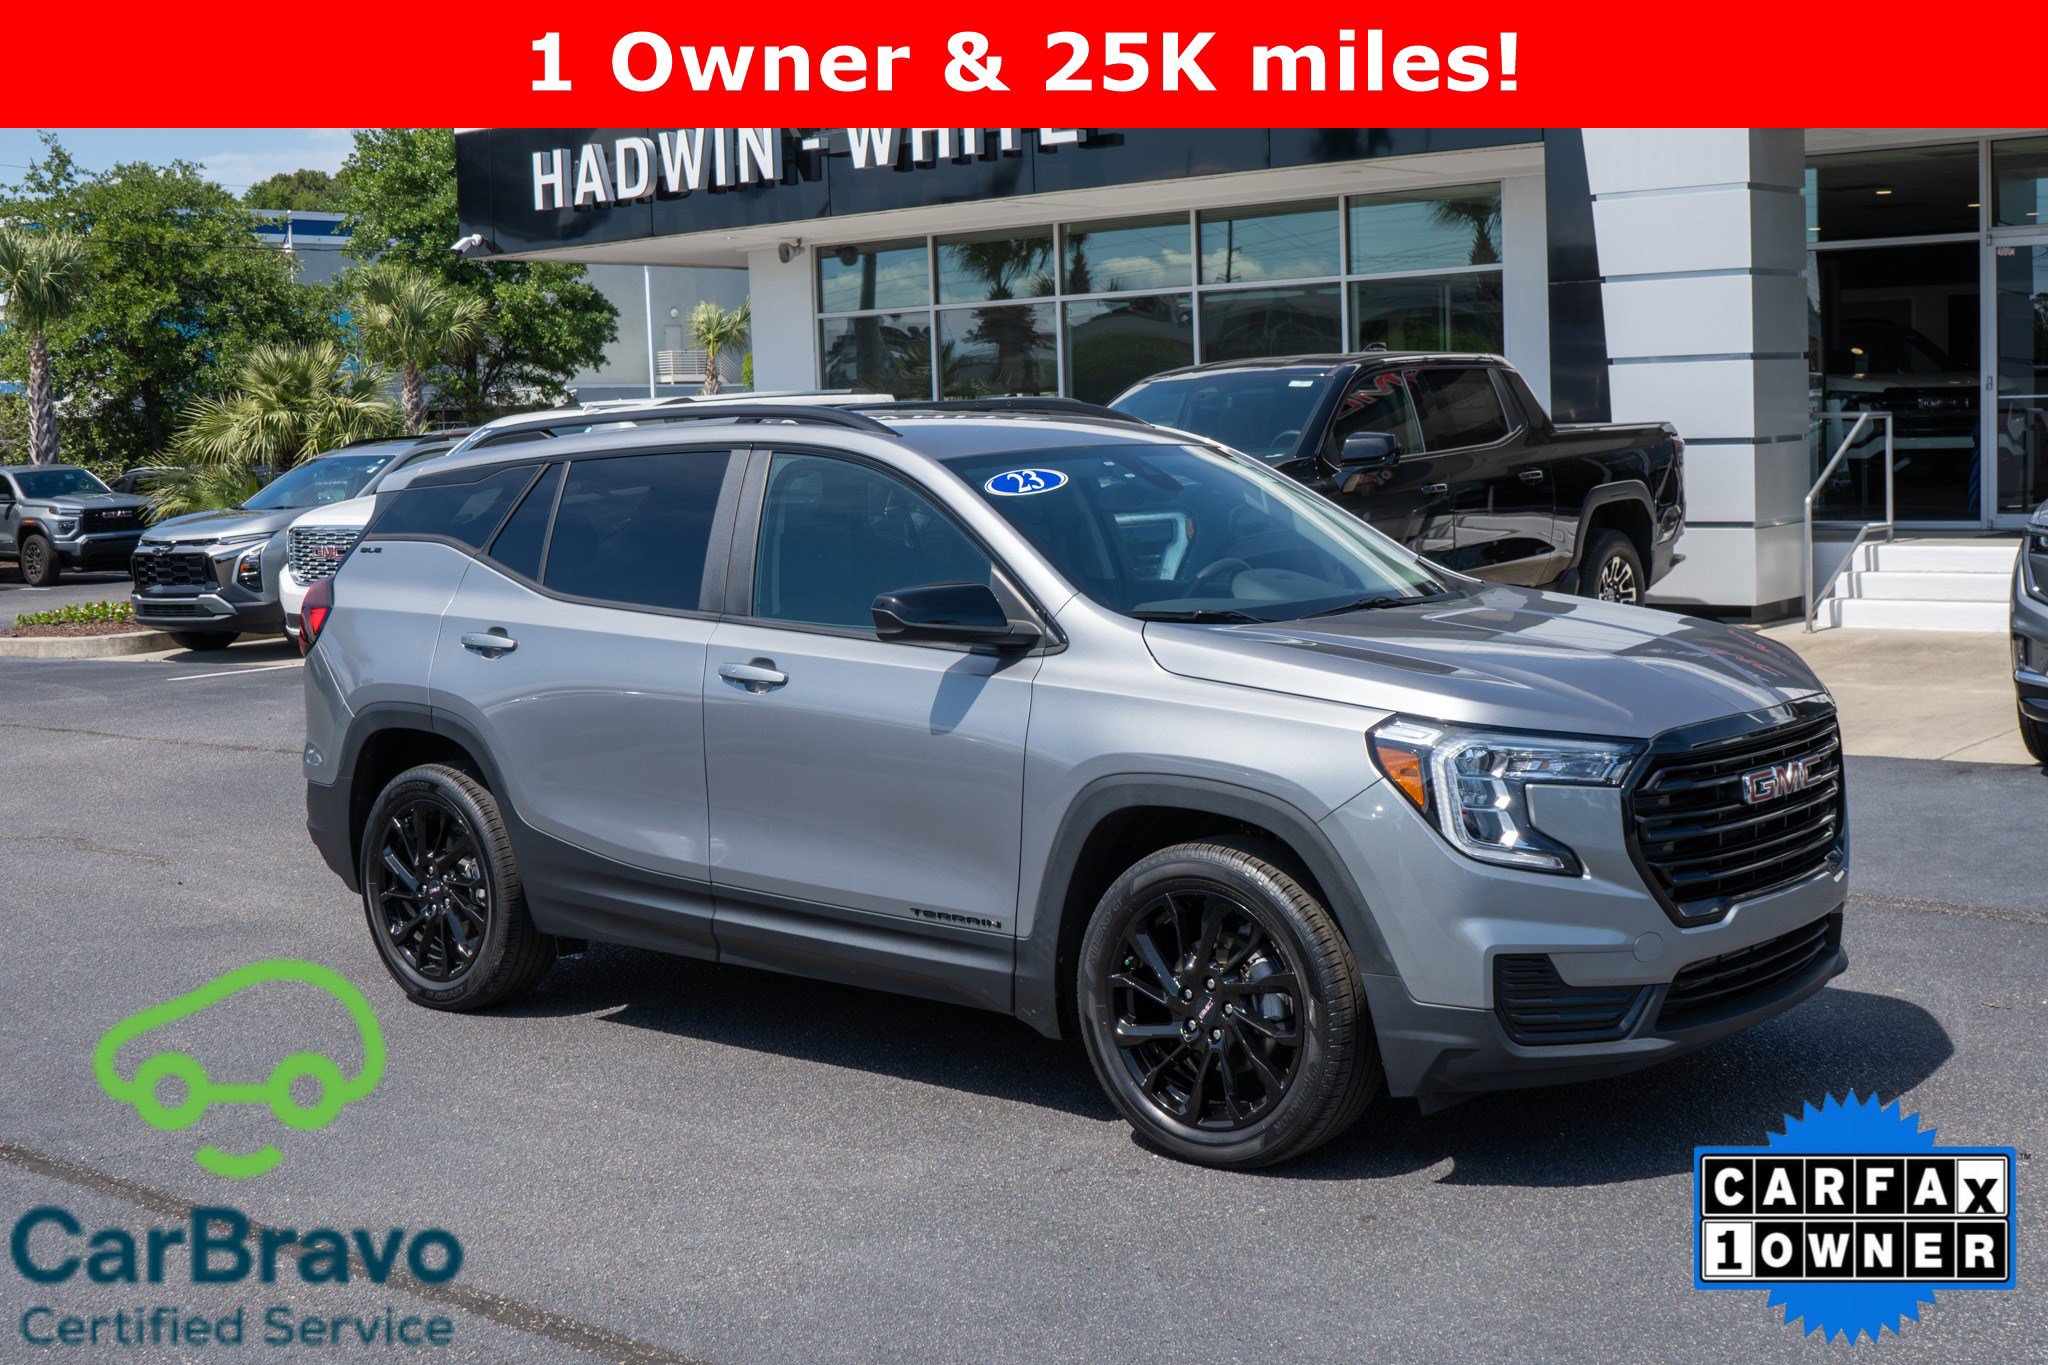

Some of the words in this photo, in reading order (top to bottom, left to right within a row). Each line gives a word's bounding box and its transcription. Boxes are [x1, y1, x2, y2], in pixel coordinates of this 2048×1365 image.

[532, 128, 782, 211] HADWIN
[1007, 470, 1045, 493] 23
[1742, 754, 1822, 804] GMC
[910, 908, 1001, 928] TERRAIN
